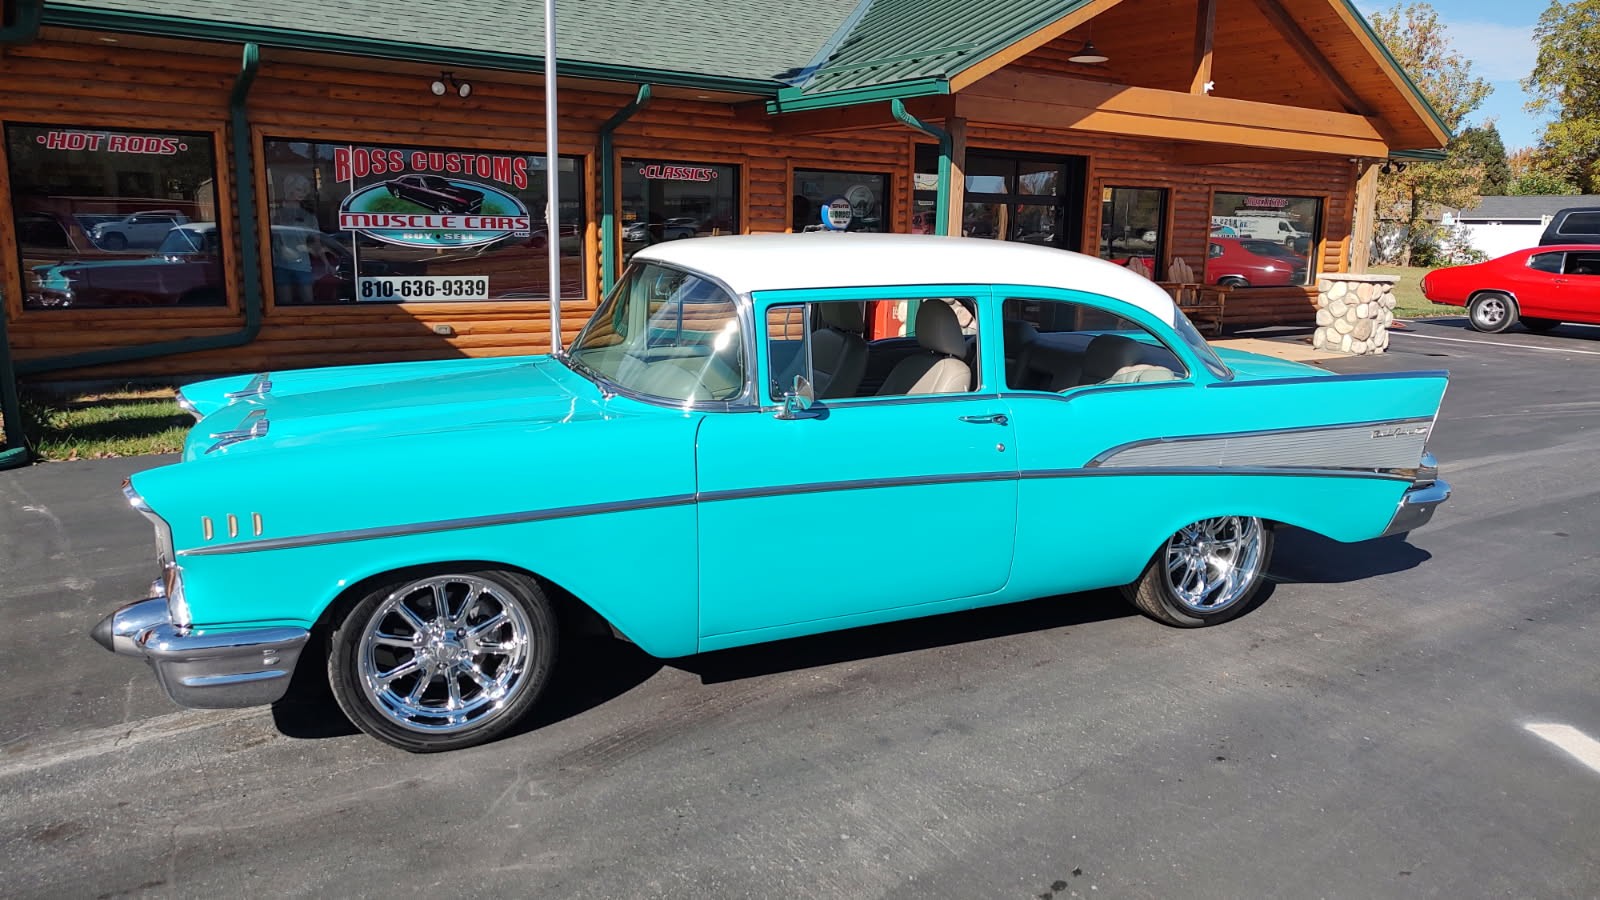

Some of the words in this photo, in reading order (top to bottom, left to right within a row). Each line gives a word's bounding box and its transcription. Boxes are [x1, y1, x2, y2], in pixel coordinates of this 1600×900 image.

[47, 131, 104, 151] HOT
[108, 134, 179, 155] RODS
[334, 147, 404, 183] ROSS
[411, 151, 528, 190] CUSTOMS
[644, 164, 713, 182] CLASSICS
[340, 214, 457, 229] MUSCLE
[464, 216, 529, 230] CARS
[402, 232, 433, 240] BUY
[361, 279, 487, 298] 810-636-9339
